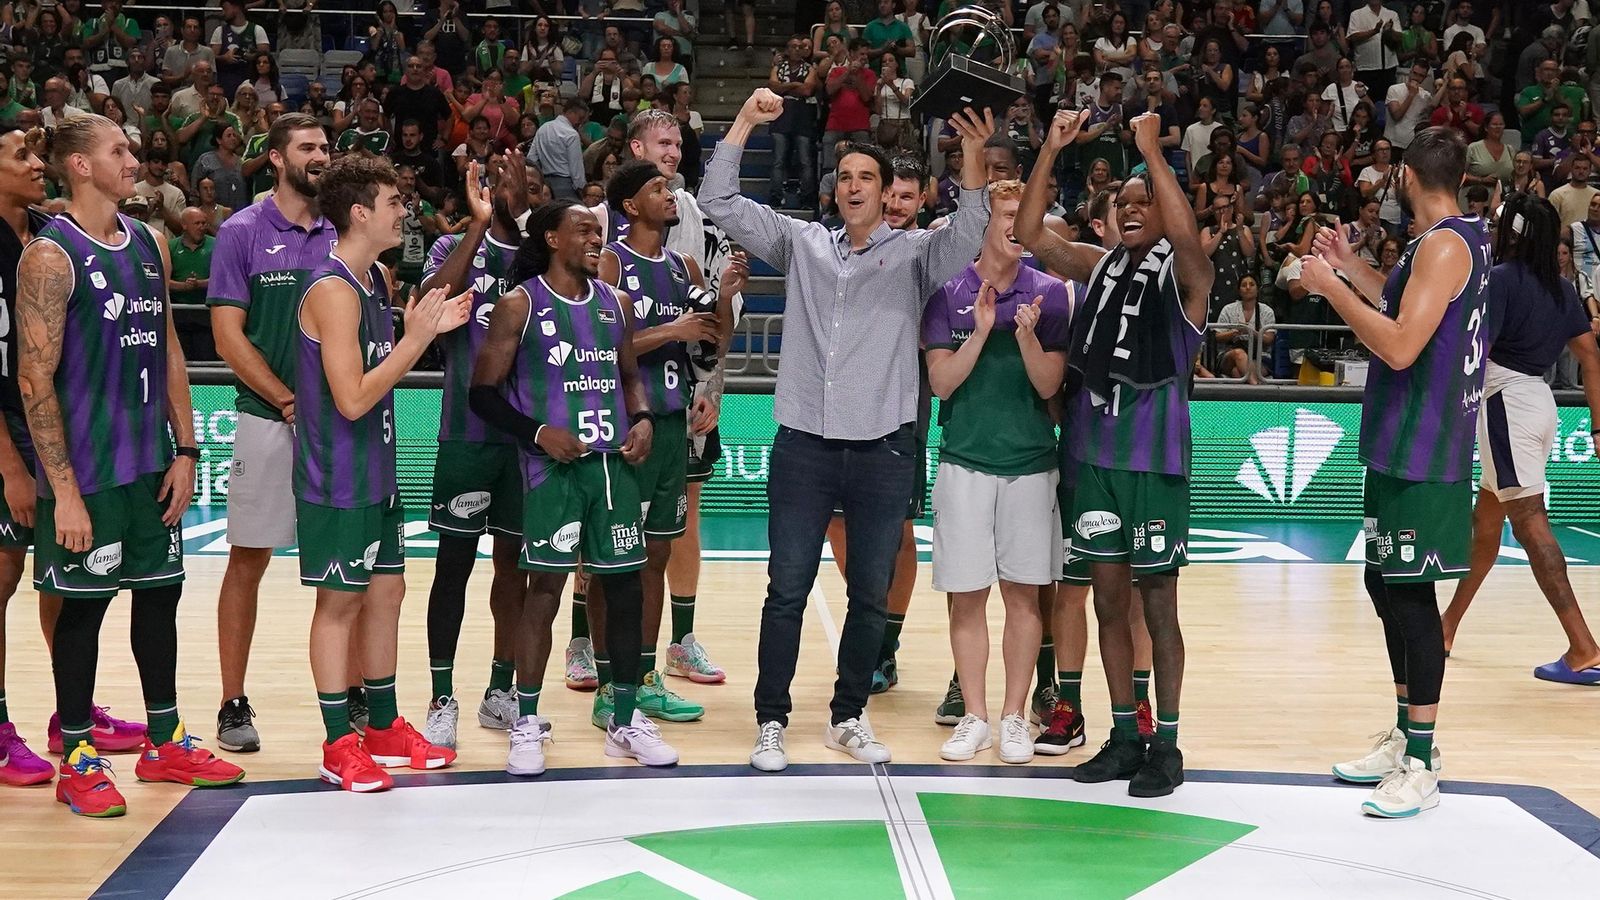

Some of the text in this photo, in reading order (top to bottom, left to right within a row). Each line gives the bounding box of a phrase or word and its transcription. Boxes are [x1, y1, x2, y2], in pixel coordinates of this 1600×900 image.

[126, 296, 163, 316] Unicja
[655, 302, 684, 316] Unica
[574, 347, 618, 365] Unicaj
[563, 374, 616, 393] málaga
[663, 359, 679, 390] 6
[140, 367, 149, 403] 1
[577, 408, 615, 444] 55
